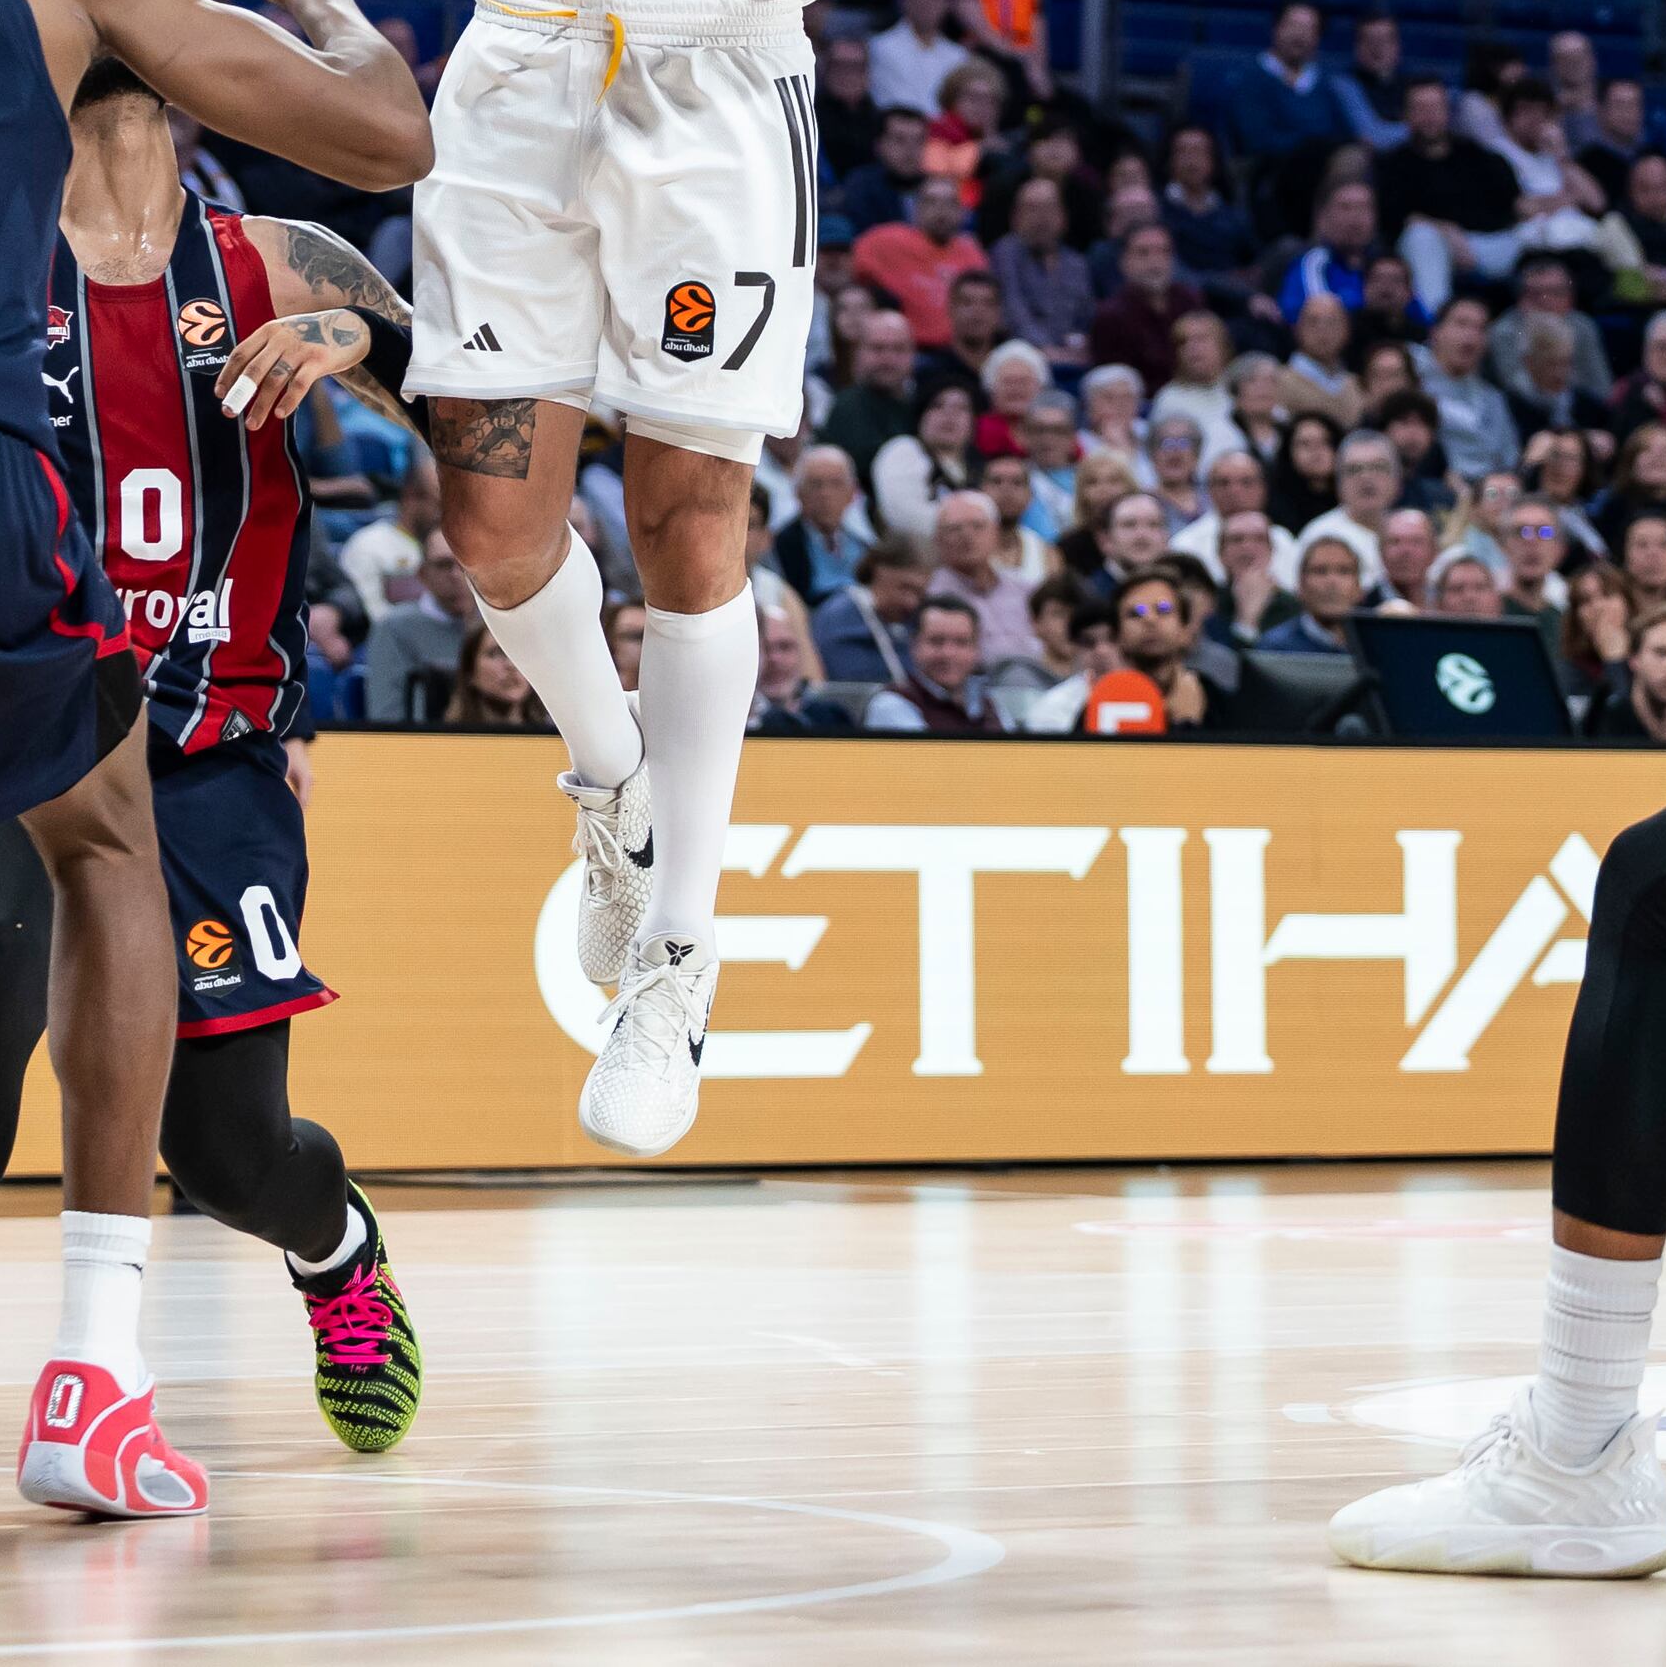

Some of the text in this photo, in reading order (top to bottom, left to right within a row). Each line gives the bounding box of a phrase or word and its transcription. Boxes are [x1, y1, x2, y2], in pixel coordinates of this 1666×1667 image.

[720, 271, 776, 371] 7
[119, 467, 183, 563] 0
[238, 884, 304, 981] 0
